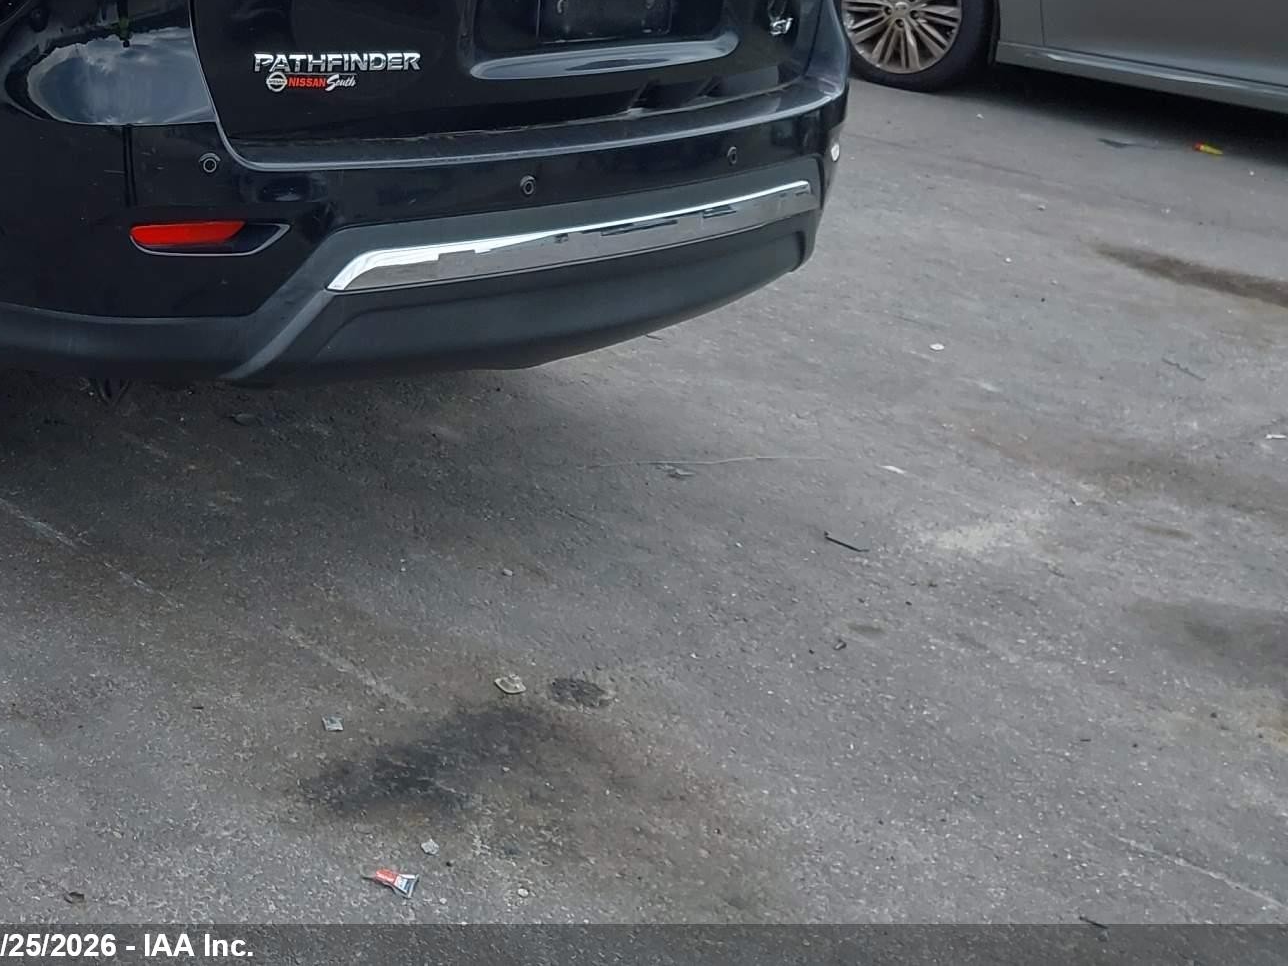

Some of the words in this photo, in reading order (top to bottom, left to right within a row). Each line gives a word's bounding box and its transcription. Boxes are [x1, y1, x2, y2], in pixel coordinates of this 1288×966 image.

[253, 52, 421, 72] PATHFINDER
[288, 77, 326, 87] NISSAN
[325, 74, 357, 91] South
